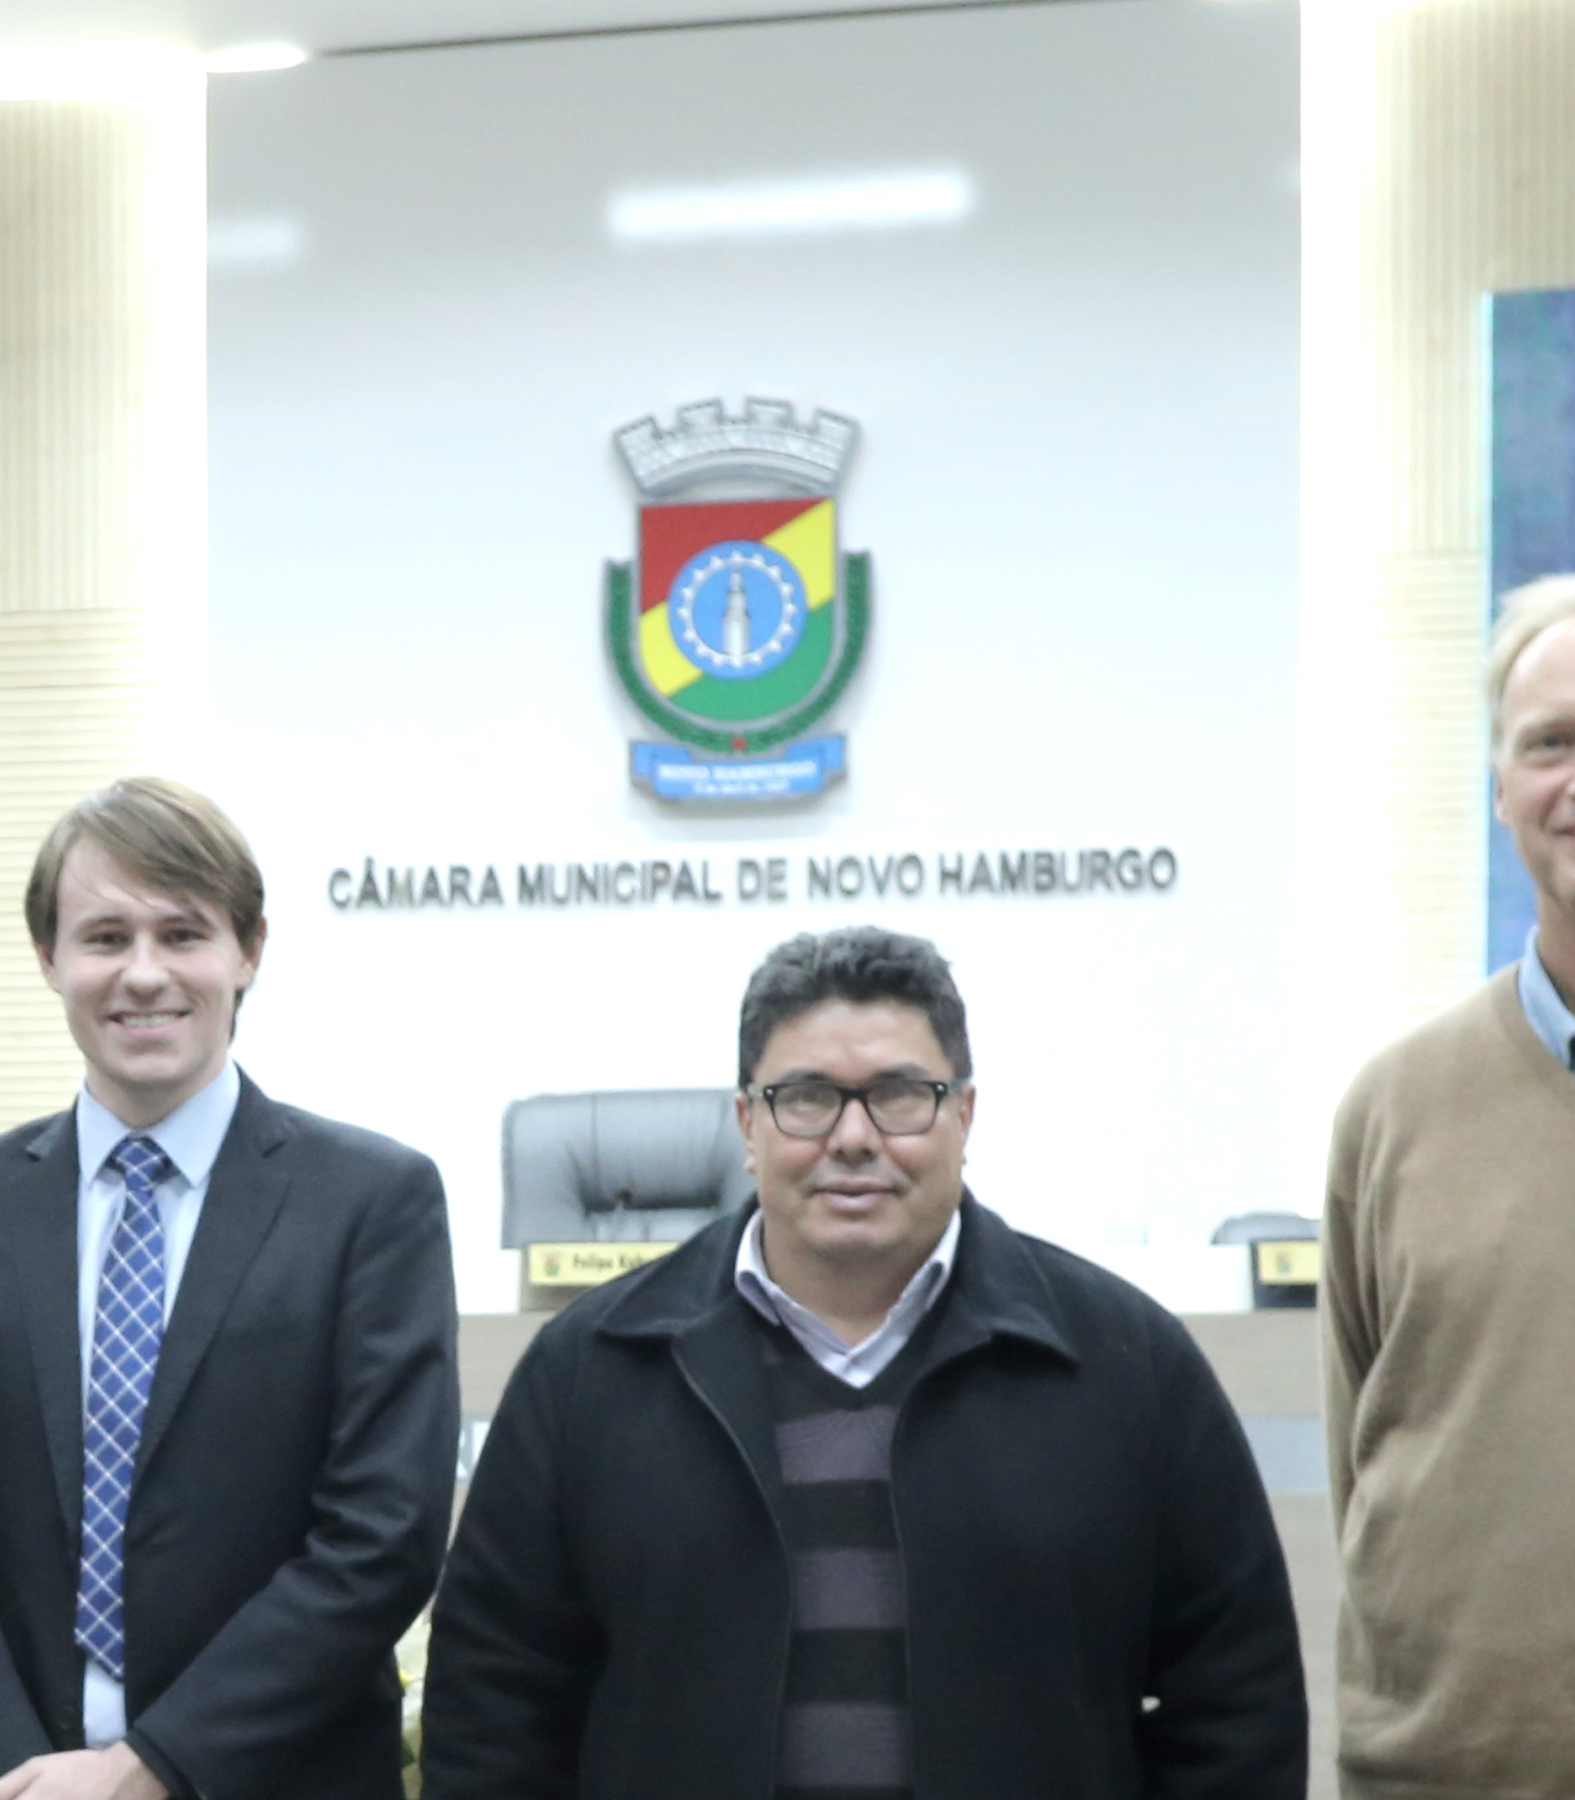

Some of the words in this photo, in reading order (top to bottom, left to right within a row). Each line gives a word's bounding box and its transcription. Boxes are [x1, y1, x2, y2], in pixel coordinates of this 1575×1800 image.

[327, 855, 506, 909] CÂMARA
[517, 860, 723, 904] MUNICIPAL
[737, 857, 788, 901] DE
[807, 853, 925, 898] NOVO
[939, 847, 1177, 894] HAMBURGO
